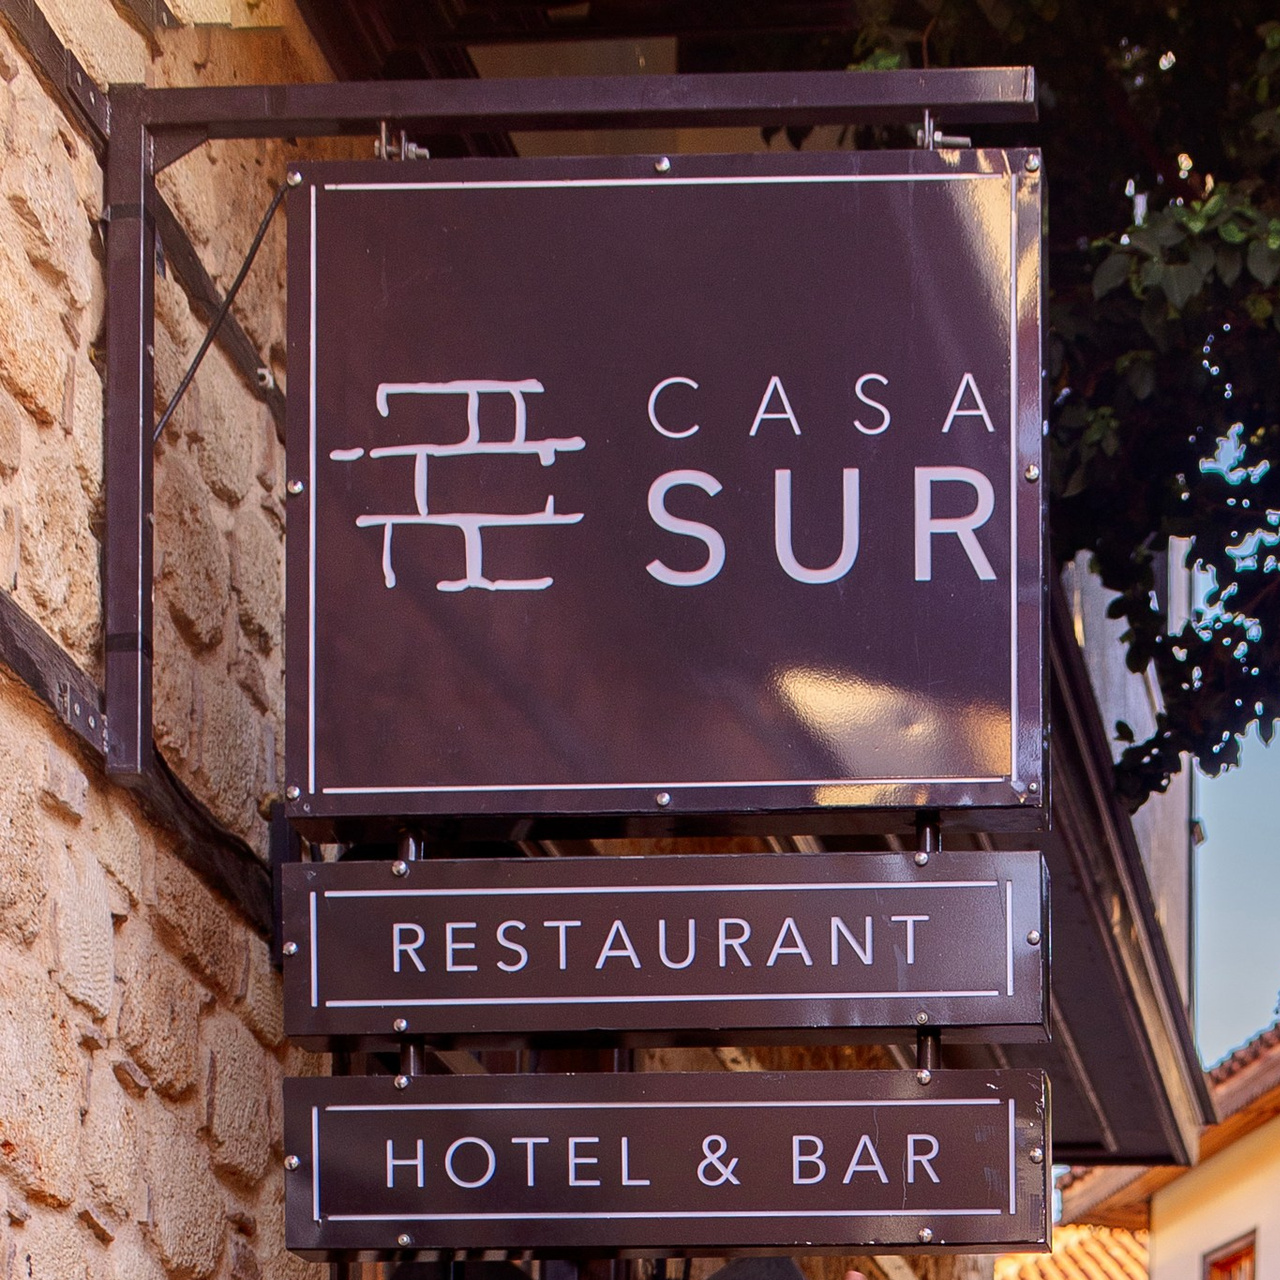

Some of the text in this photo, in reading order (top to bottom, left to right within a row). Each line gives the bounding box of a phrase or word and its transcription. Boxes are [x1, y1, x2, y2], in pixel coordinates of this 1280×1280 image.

[647, 372, 995, 439] CASA
[645, 466, 998, 587] SUR
[392, 914, 930, 973] RESTAURANT
[386, 1133, 940, 1189] HOTEL & BAR
